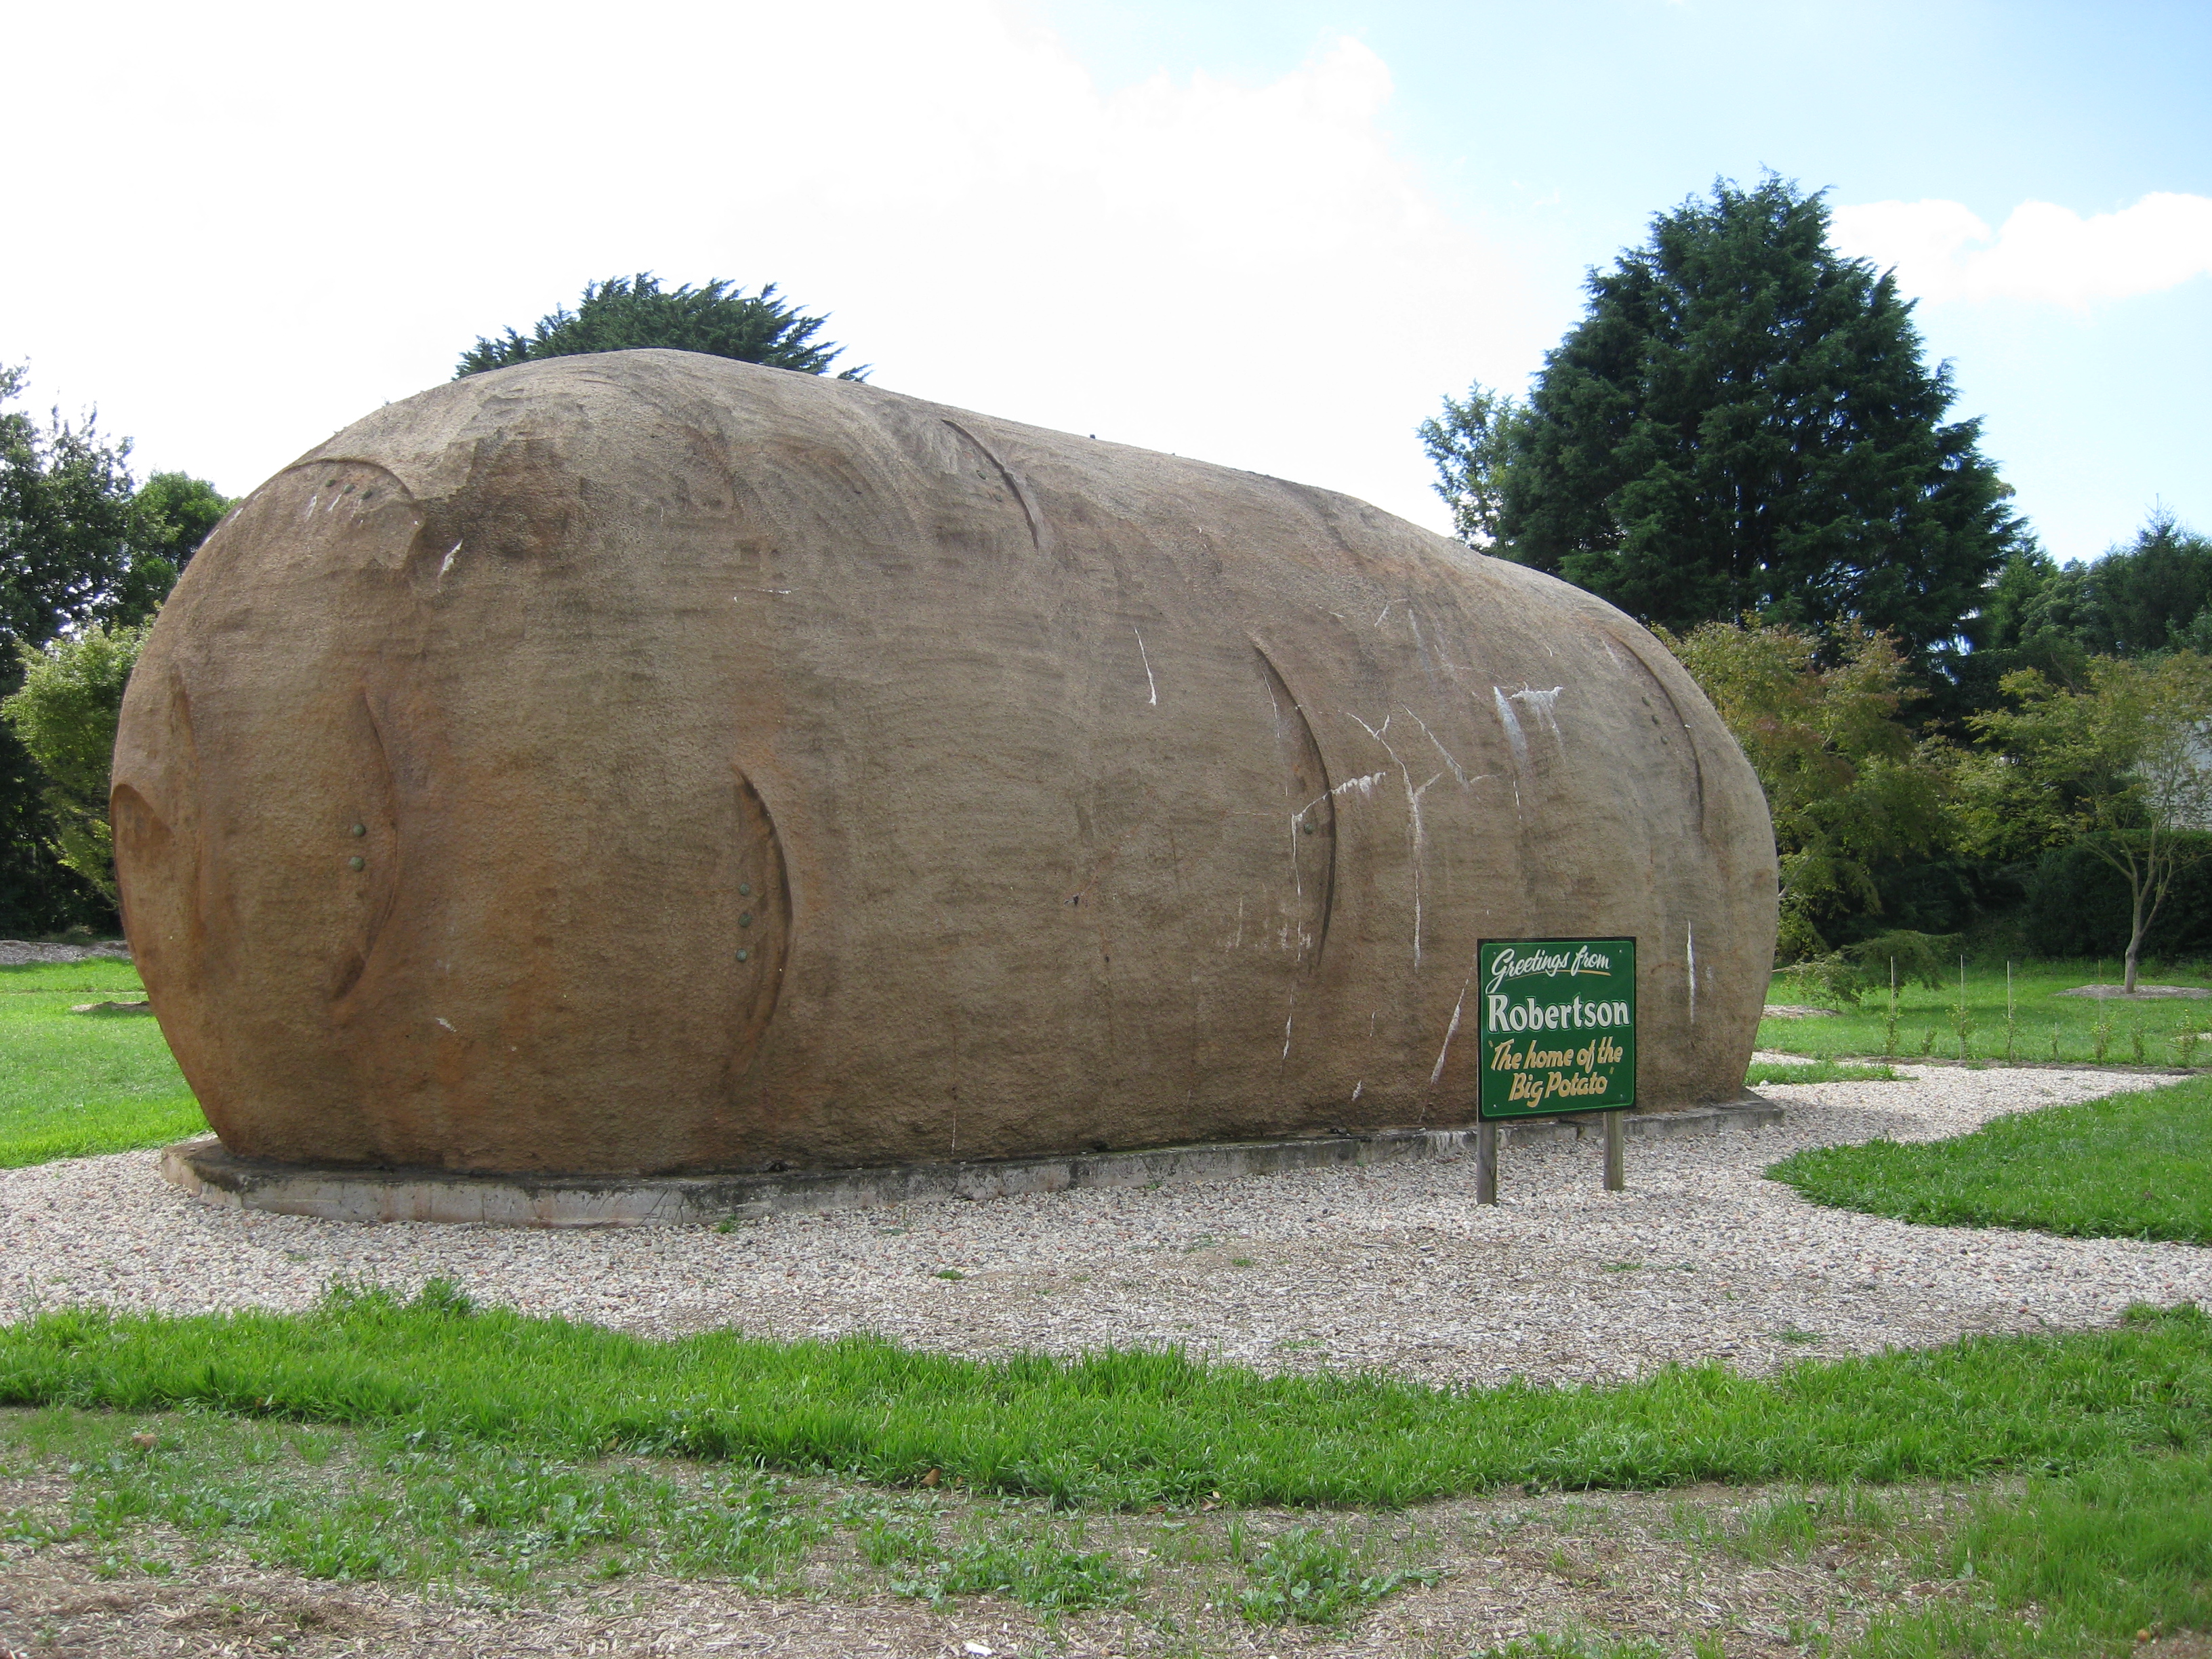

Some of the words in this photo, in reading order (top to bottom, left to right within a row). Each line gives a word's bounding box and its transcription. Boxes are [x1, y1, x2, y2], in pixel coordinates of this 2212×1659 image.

[1486, 948, 1570, 994] Greetings
[1570, 945, 1610, 977] from
[1487, 994, 1631, 1033] Robertson
[1523, 1040, 1574, 1069] home
[1576, 1039, 1597, 1073] of
[1597, 1036, 1623, 1063] the
[1508, 1072, 1544, 1107] Big
